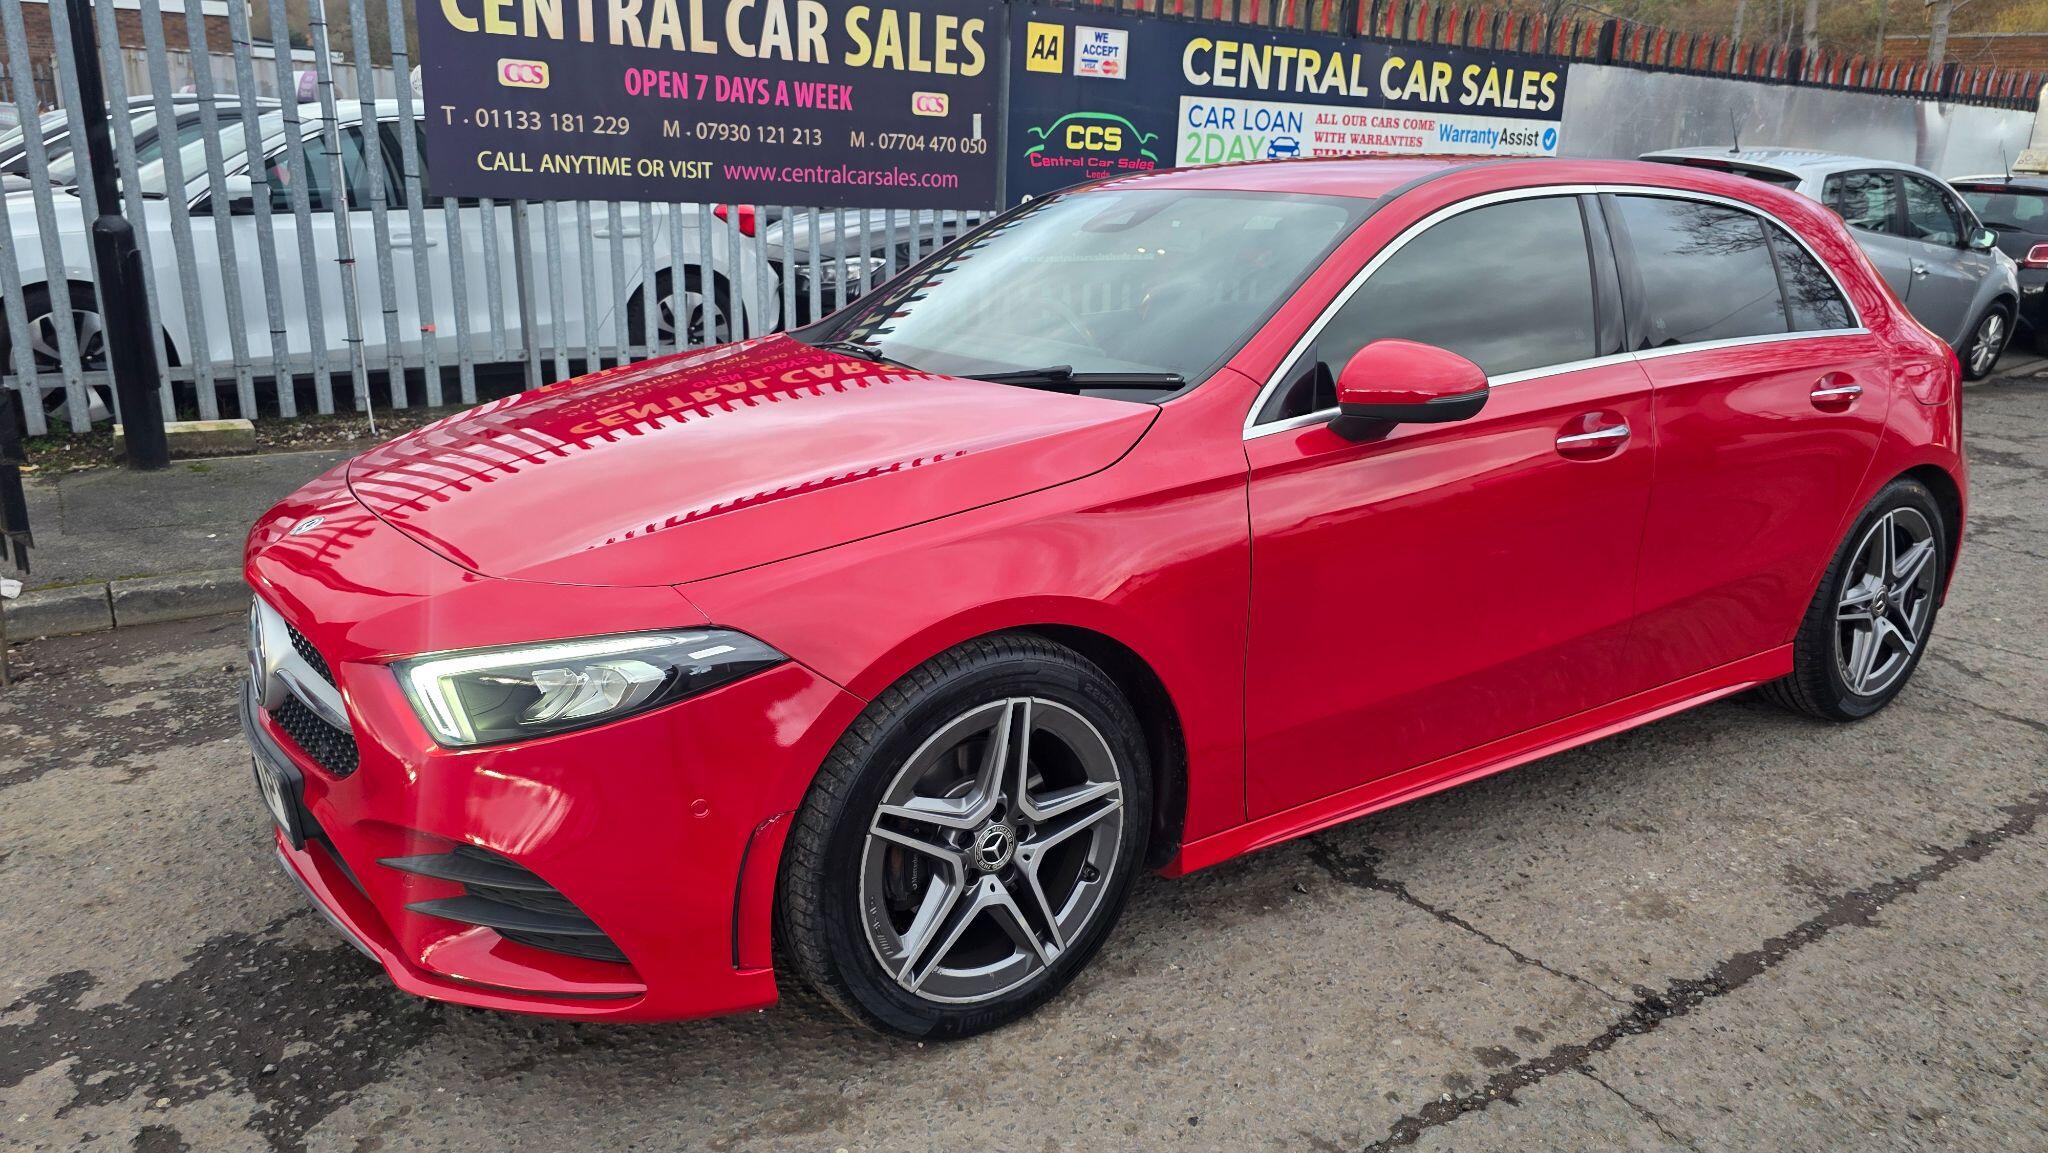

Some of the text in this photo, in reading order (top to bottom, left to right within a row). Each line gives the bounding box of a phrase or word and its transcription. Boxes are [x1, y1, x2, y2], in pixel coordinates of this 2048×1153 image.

[725, 0, 829, 64] CAR
[844, 5, 986, 77] SALES
[1031, 34, 1058, 60] AA
[1094, 31, 1109, 43] WE
[1083, 44, 1119, 57] ACCEPT
[1182, 37, 1558, 112] CENTRAL CAR SALES
[624, 67, 853, 111] OPEN 7 DAYS A WEEK
[475, 107, 542, 131] 01133
[550, 113, 584, 133] 181
[592, 115, 630, 136] 229
[1188, 104, 1303, 134] CAR LOAN
[1315, 113, 1436, 131] ALL OUR CARS COME
[696, 121, 751, 142] 07930
[757, 126, 784, 144] 121
[792, 127, 822, 146] 213
[879, 133, 925, 151] 07704
[929, 136, 956, 153] 470
[960, 138, 987, 154] 050
[1066, 125, 1122, 151] CCS
[1314, 131, 1423, 148] WITH WARRANTIES
[1186, 131, 1266, 163] 2DAY
[477, 150, 959, 189] CALL ANYTIME OR VISIT www.centralcarsales.com
[1030, 152, 1156, 170] Central Car Sales
